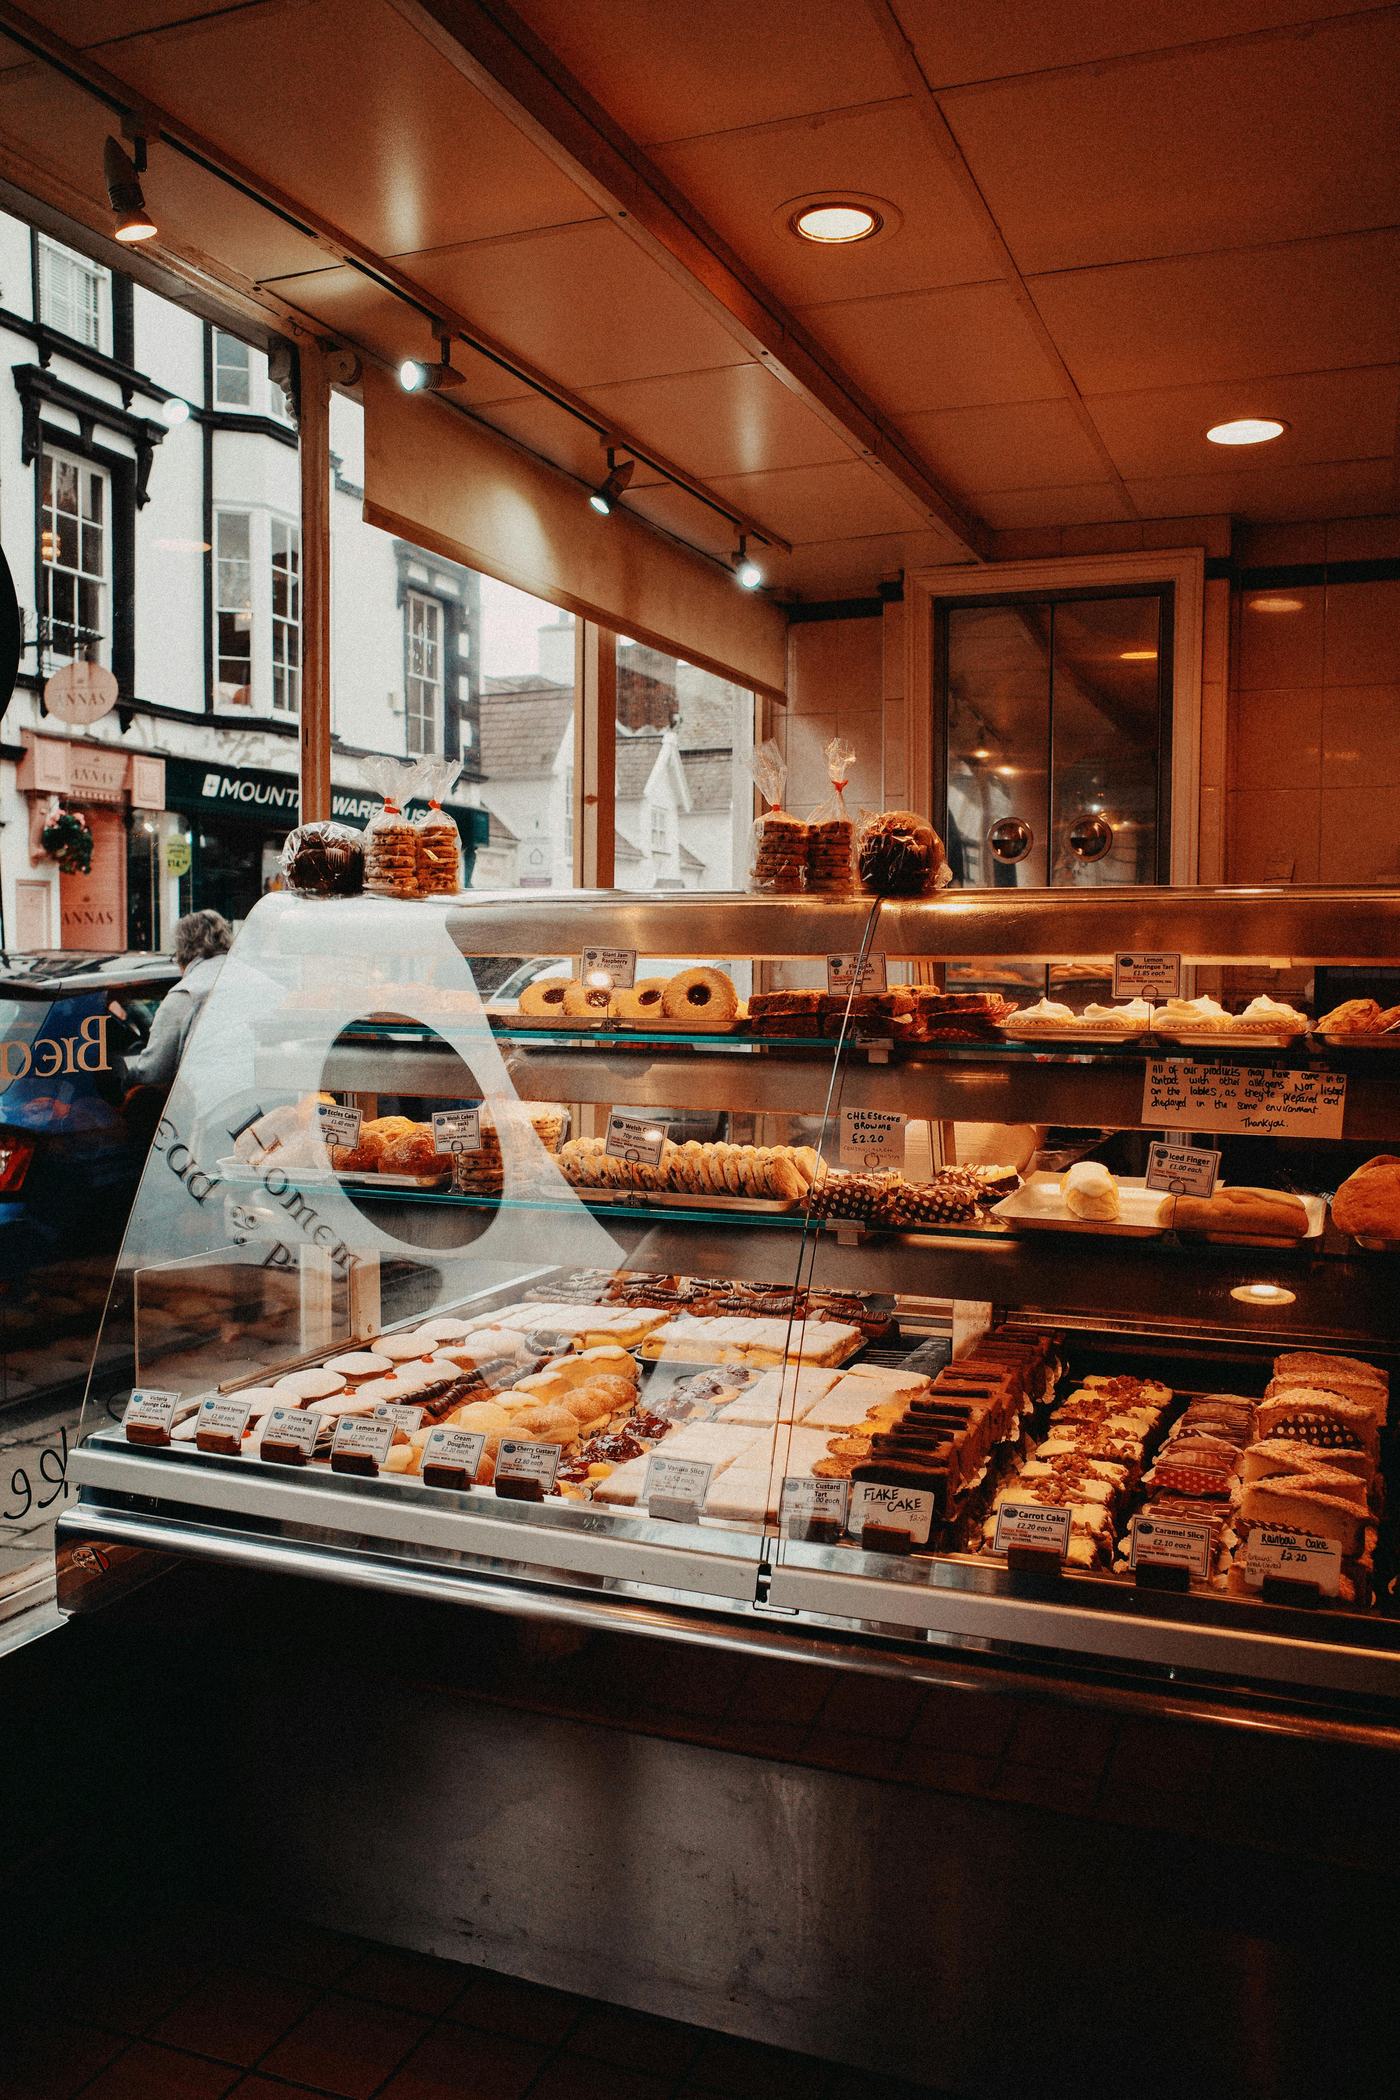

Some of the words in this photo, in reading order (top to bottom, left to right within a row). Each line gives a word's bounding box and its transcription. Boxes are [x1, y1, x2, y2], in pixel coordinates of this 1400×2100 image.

[220, 777, 299, 808] MOUNT
[62, 911, 113, 926] ANNAS
[602, 957, 628, 966] Raspberry
[1152, 1064, 1163, 1074] All
[1168, 1064, 1178, 1075] of
[1183, 1066, 1198, 1074] our
[1203, 1066, 1241, 1078] products
[1247, 1068, 1265, 1081] may
[1272, 1069, 1291, 1079] have
[1301, 1072, 1320, 1081] come
[1189, 1076, 1209, 1085] with
[1219, 1076, 1240, 1086] other
[1320, 1084, 1345, 1096] listed
[1150, 1087, 1161, 1095] on
[1167, 1086, 1181, 1096] the
[1283, 1092, 1318, 1105] prepared
[1323, 1095, 1339, 1105] and
[1151, 1096, 1187, 1110] displayed
[1196, 1100, 1205, 1108] in
[1214, 1099, 1228, 1109] the
[1237, 1101, 1258, 1111] same
[1265, 1103, 1319, 1114] environment
[327, 1109, 343, 1117] Eccles
[344, 1112, 358, 1120] Cake
[847, 1112, 900, 1122] CHEESECAKE
[625, 1122, 642, 1131] Welsh
[854, 1121, 892, 1130] BROWNIE
[851, 1133, 884, 1144] £2.20
[1169, 1153, 1185, 1161] Iced
[1186, 1155, 1210, 1166] Finger
[1170, 1163, 1187, 1171] £1.00
[453, 1434, 472, 1442] Cream
[447, 1441, 475, 1450] Doughnut
[517, 1445, 534, 1453] Cherry
[535, 1447, 557, 1455] Custard
[668, 1464, 689, 1472] Vanilla
[815, 1482, 840, 1490] Custard
[863, 1487, 900, 1501] FLAKE
[887, 1497, 922, 1512] CAKE
[1018, 1511, 1044, 1520] Carrot
[1046, 1514, 1066, 1523] Cake
[1017, 1522, 1036, 1530] £2.20
[1154, 1526, 1186, 1536] Caramel
[1187, 1531, 1205, 1539] Slice
[1153, 1538, 1173, 1547] £2.10
[1174, 1542, 1192, 1550] each
[1261, 1533, 1297, 1545] Rainbow
[1305, 1538, 1329, 1549] Cake
